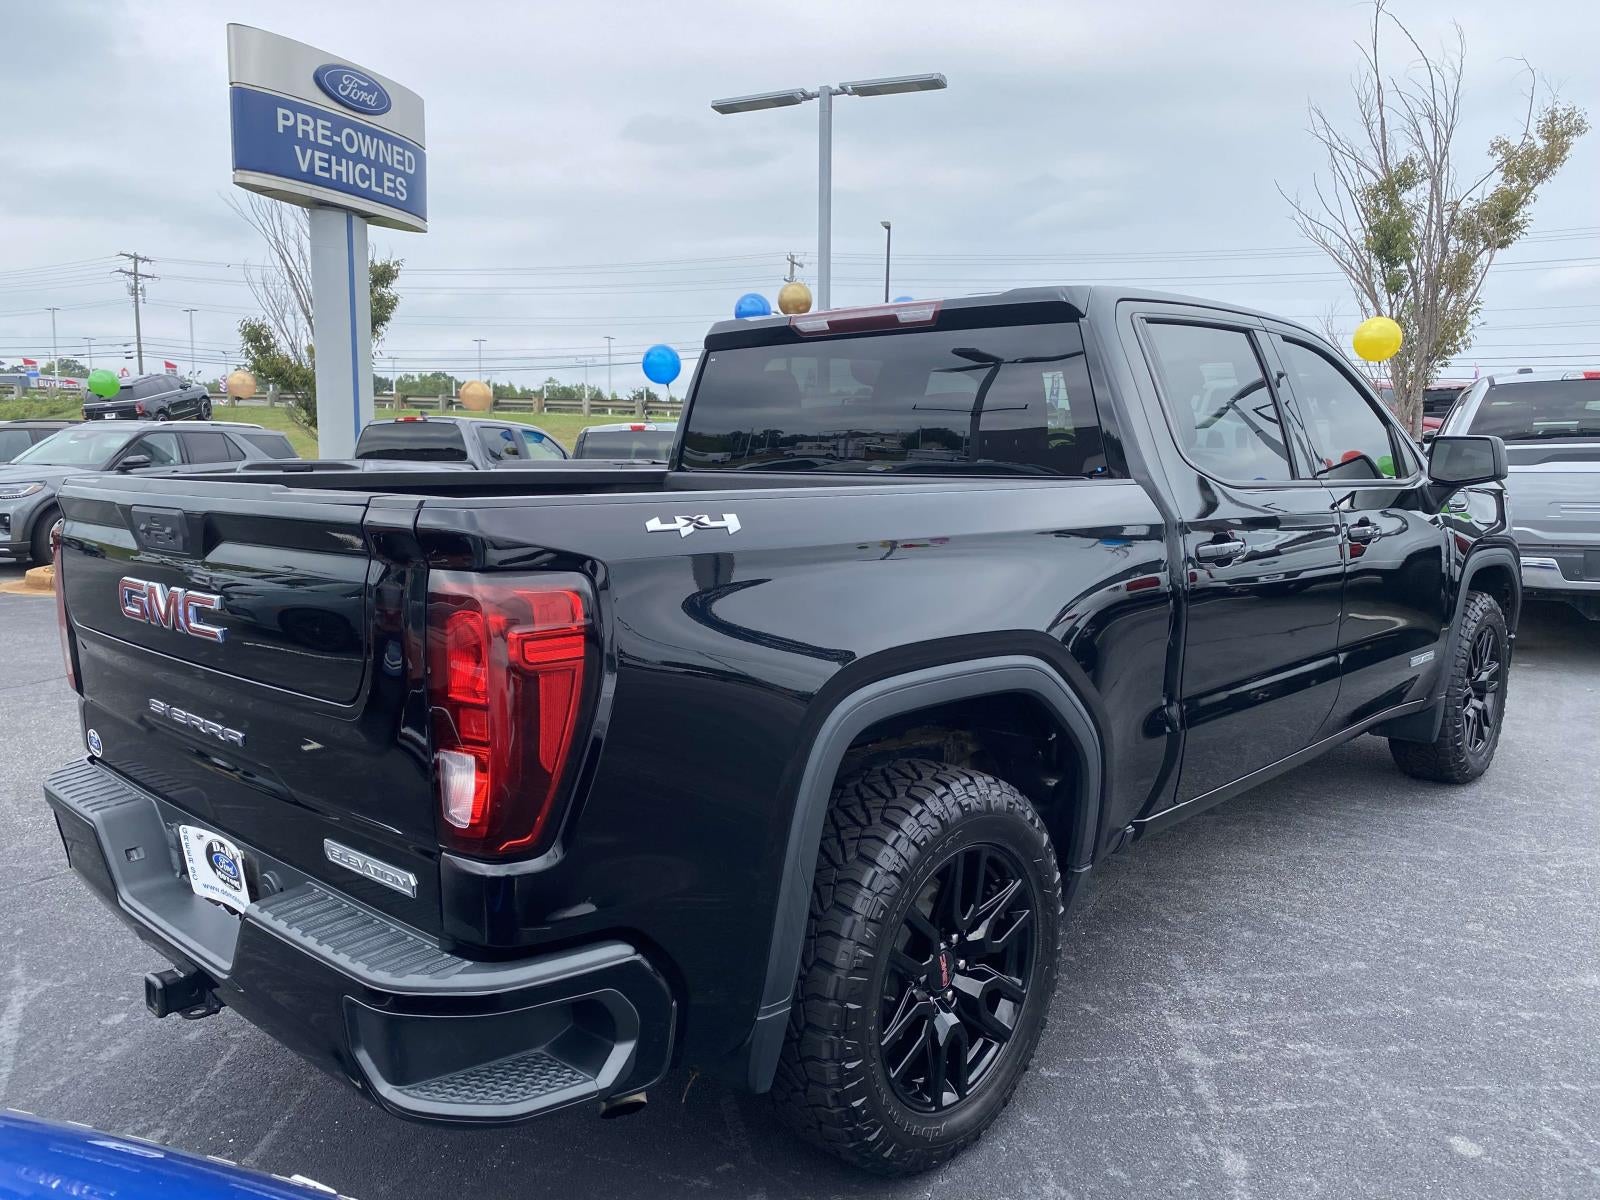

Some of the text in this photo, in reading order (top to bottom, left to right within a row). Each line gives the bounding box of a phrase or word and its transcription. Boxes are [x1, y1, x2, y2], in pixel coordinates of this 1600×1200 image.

[338, 74, 377, 107] Ford
[276, 107, 416, 175] PRE-OWNED
[294, 145, 408, 201] VEHICLES
[38, 379, 55, 388] BUY
[119, 576, 229, 644] GMC
[149, 698, 247, 748] SIERRA
[181, 827, 198, 880] GREER SC
[329, 847, 410, 890] ELEVATION
